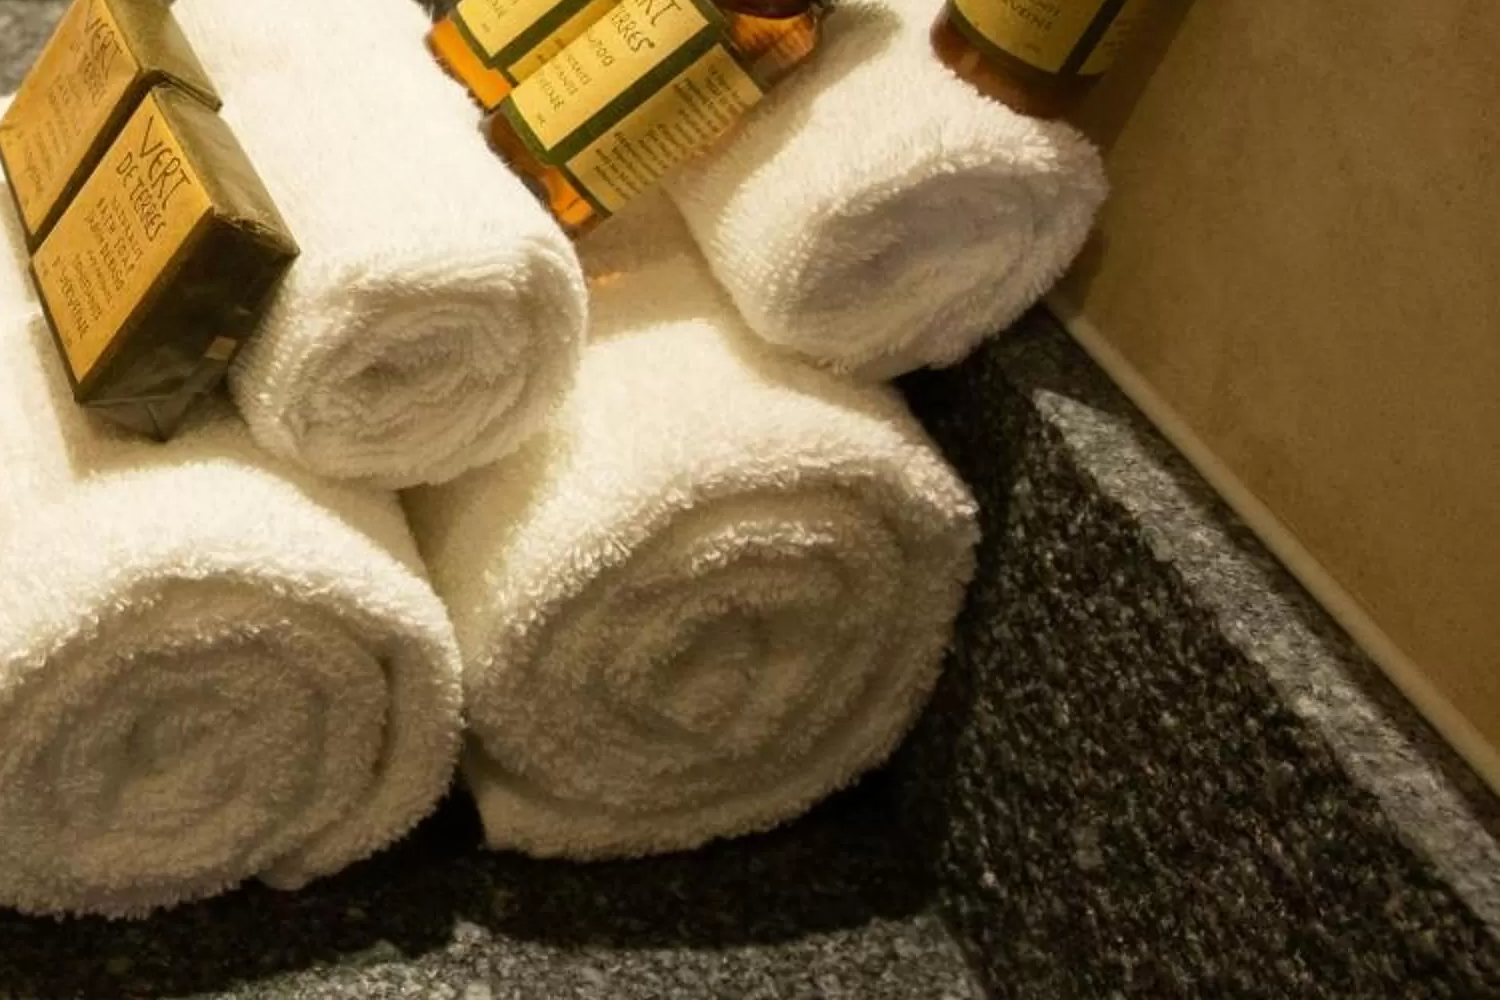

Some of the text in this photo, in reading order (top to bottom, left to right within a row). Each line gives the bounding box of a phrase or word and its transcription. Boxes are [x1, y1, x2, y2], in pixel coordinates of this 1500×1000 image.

[116, 152, 138, 188] DE
[129, 176, 166, 242] TERRES
[139, 115, 192, 211] VERT
